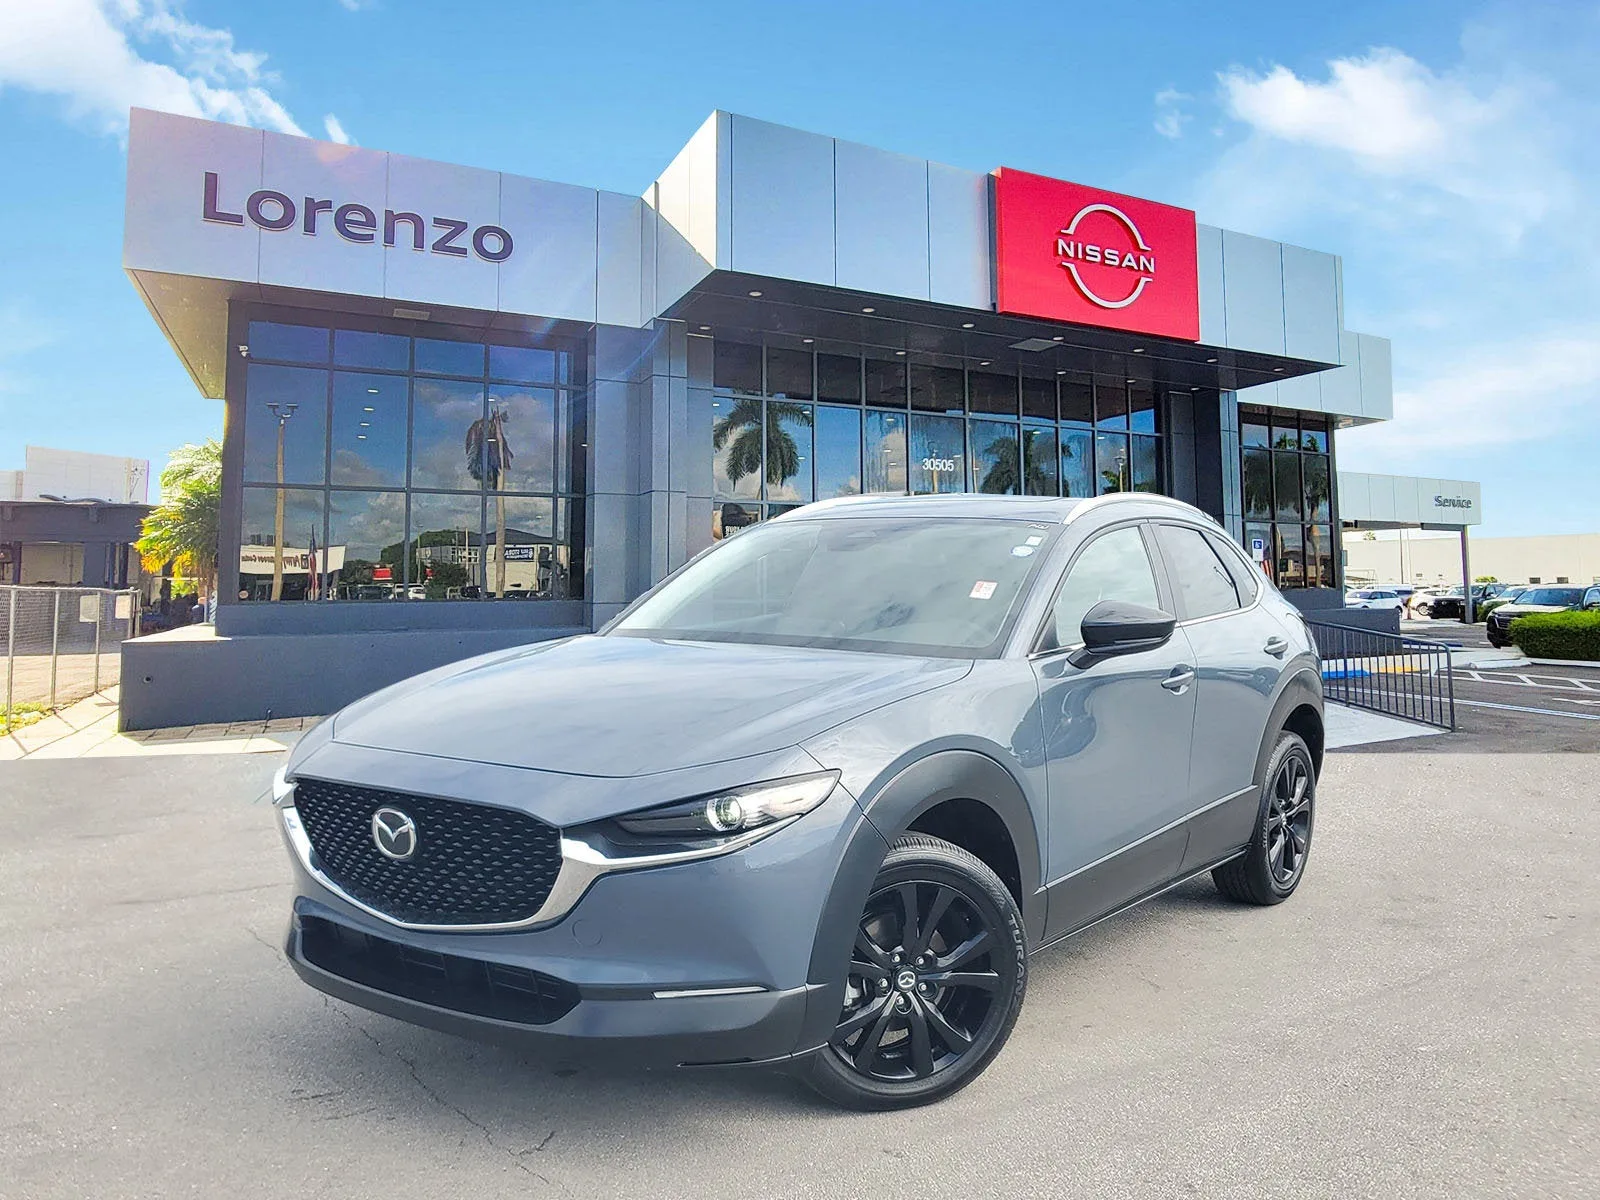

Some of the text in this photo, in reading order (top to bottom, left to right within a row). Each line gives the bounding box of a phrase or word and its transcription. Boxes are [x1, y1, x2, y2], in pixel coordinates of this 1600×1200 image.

[202, 171, 514, 262] Lorenzo
[1057, 238, 1155, 273] NISSAN
[922, 457, 954, 471] 30505
[1434, 495, 1472, 508] Service
